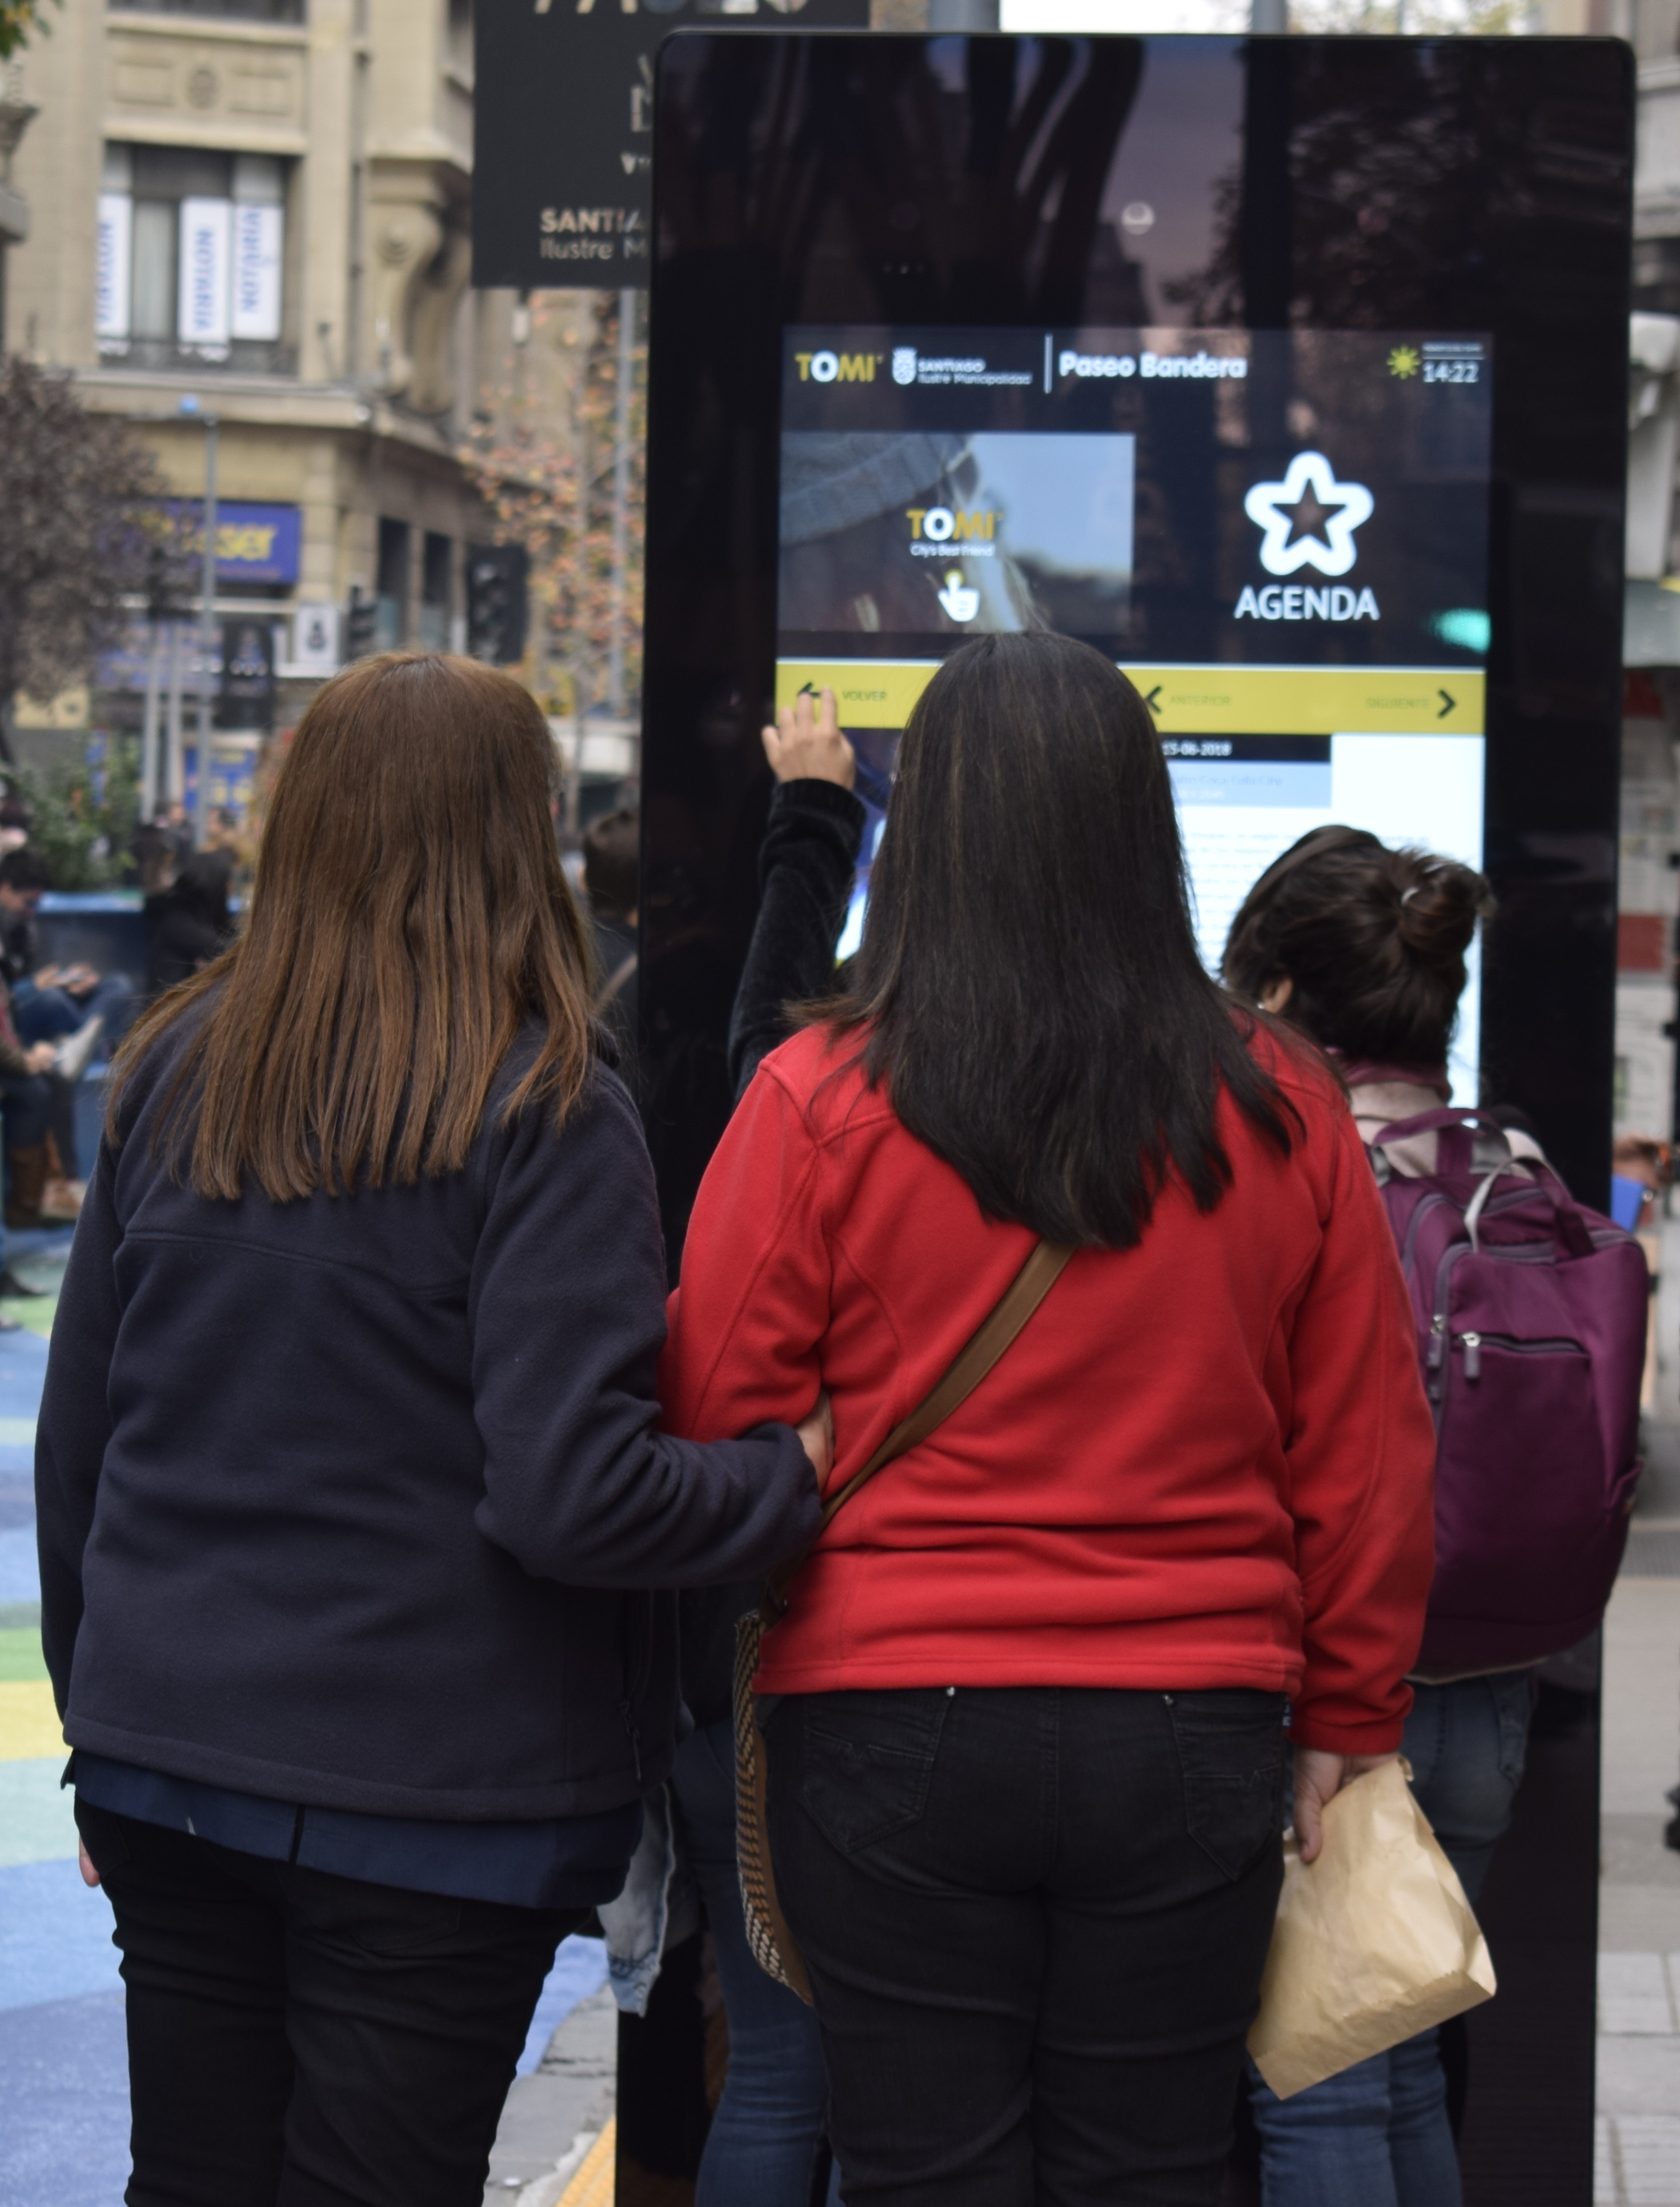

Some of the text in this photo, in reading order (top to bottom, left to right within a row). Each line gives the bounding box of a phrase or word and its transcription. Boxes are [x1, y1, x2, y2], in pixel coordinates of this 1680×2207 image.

[540, 207, 647, 233] SANTIA
[795, 350, 876, 382] TOMI
[917, 358, 986, 373] SANTIAGO
[1059, 350, 1248, 378] Paseo Bandera
[1423, 360, 1479, 383] 14:22
[905, 506, 995, 542] TOMI
[1233, 583, 1381, 621] AGENDA
[841, 689, 888, 702] VOLVER
[1169, 695, 1232, 707] ANTERIOR
[1365, 697, 1430, 710] SIGUIENTE
